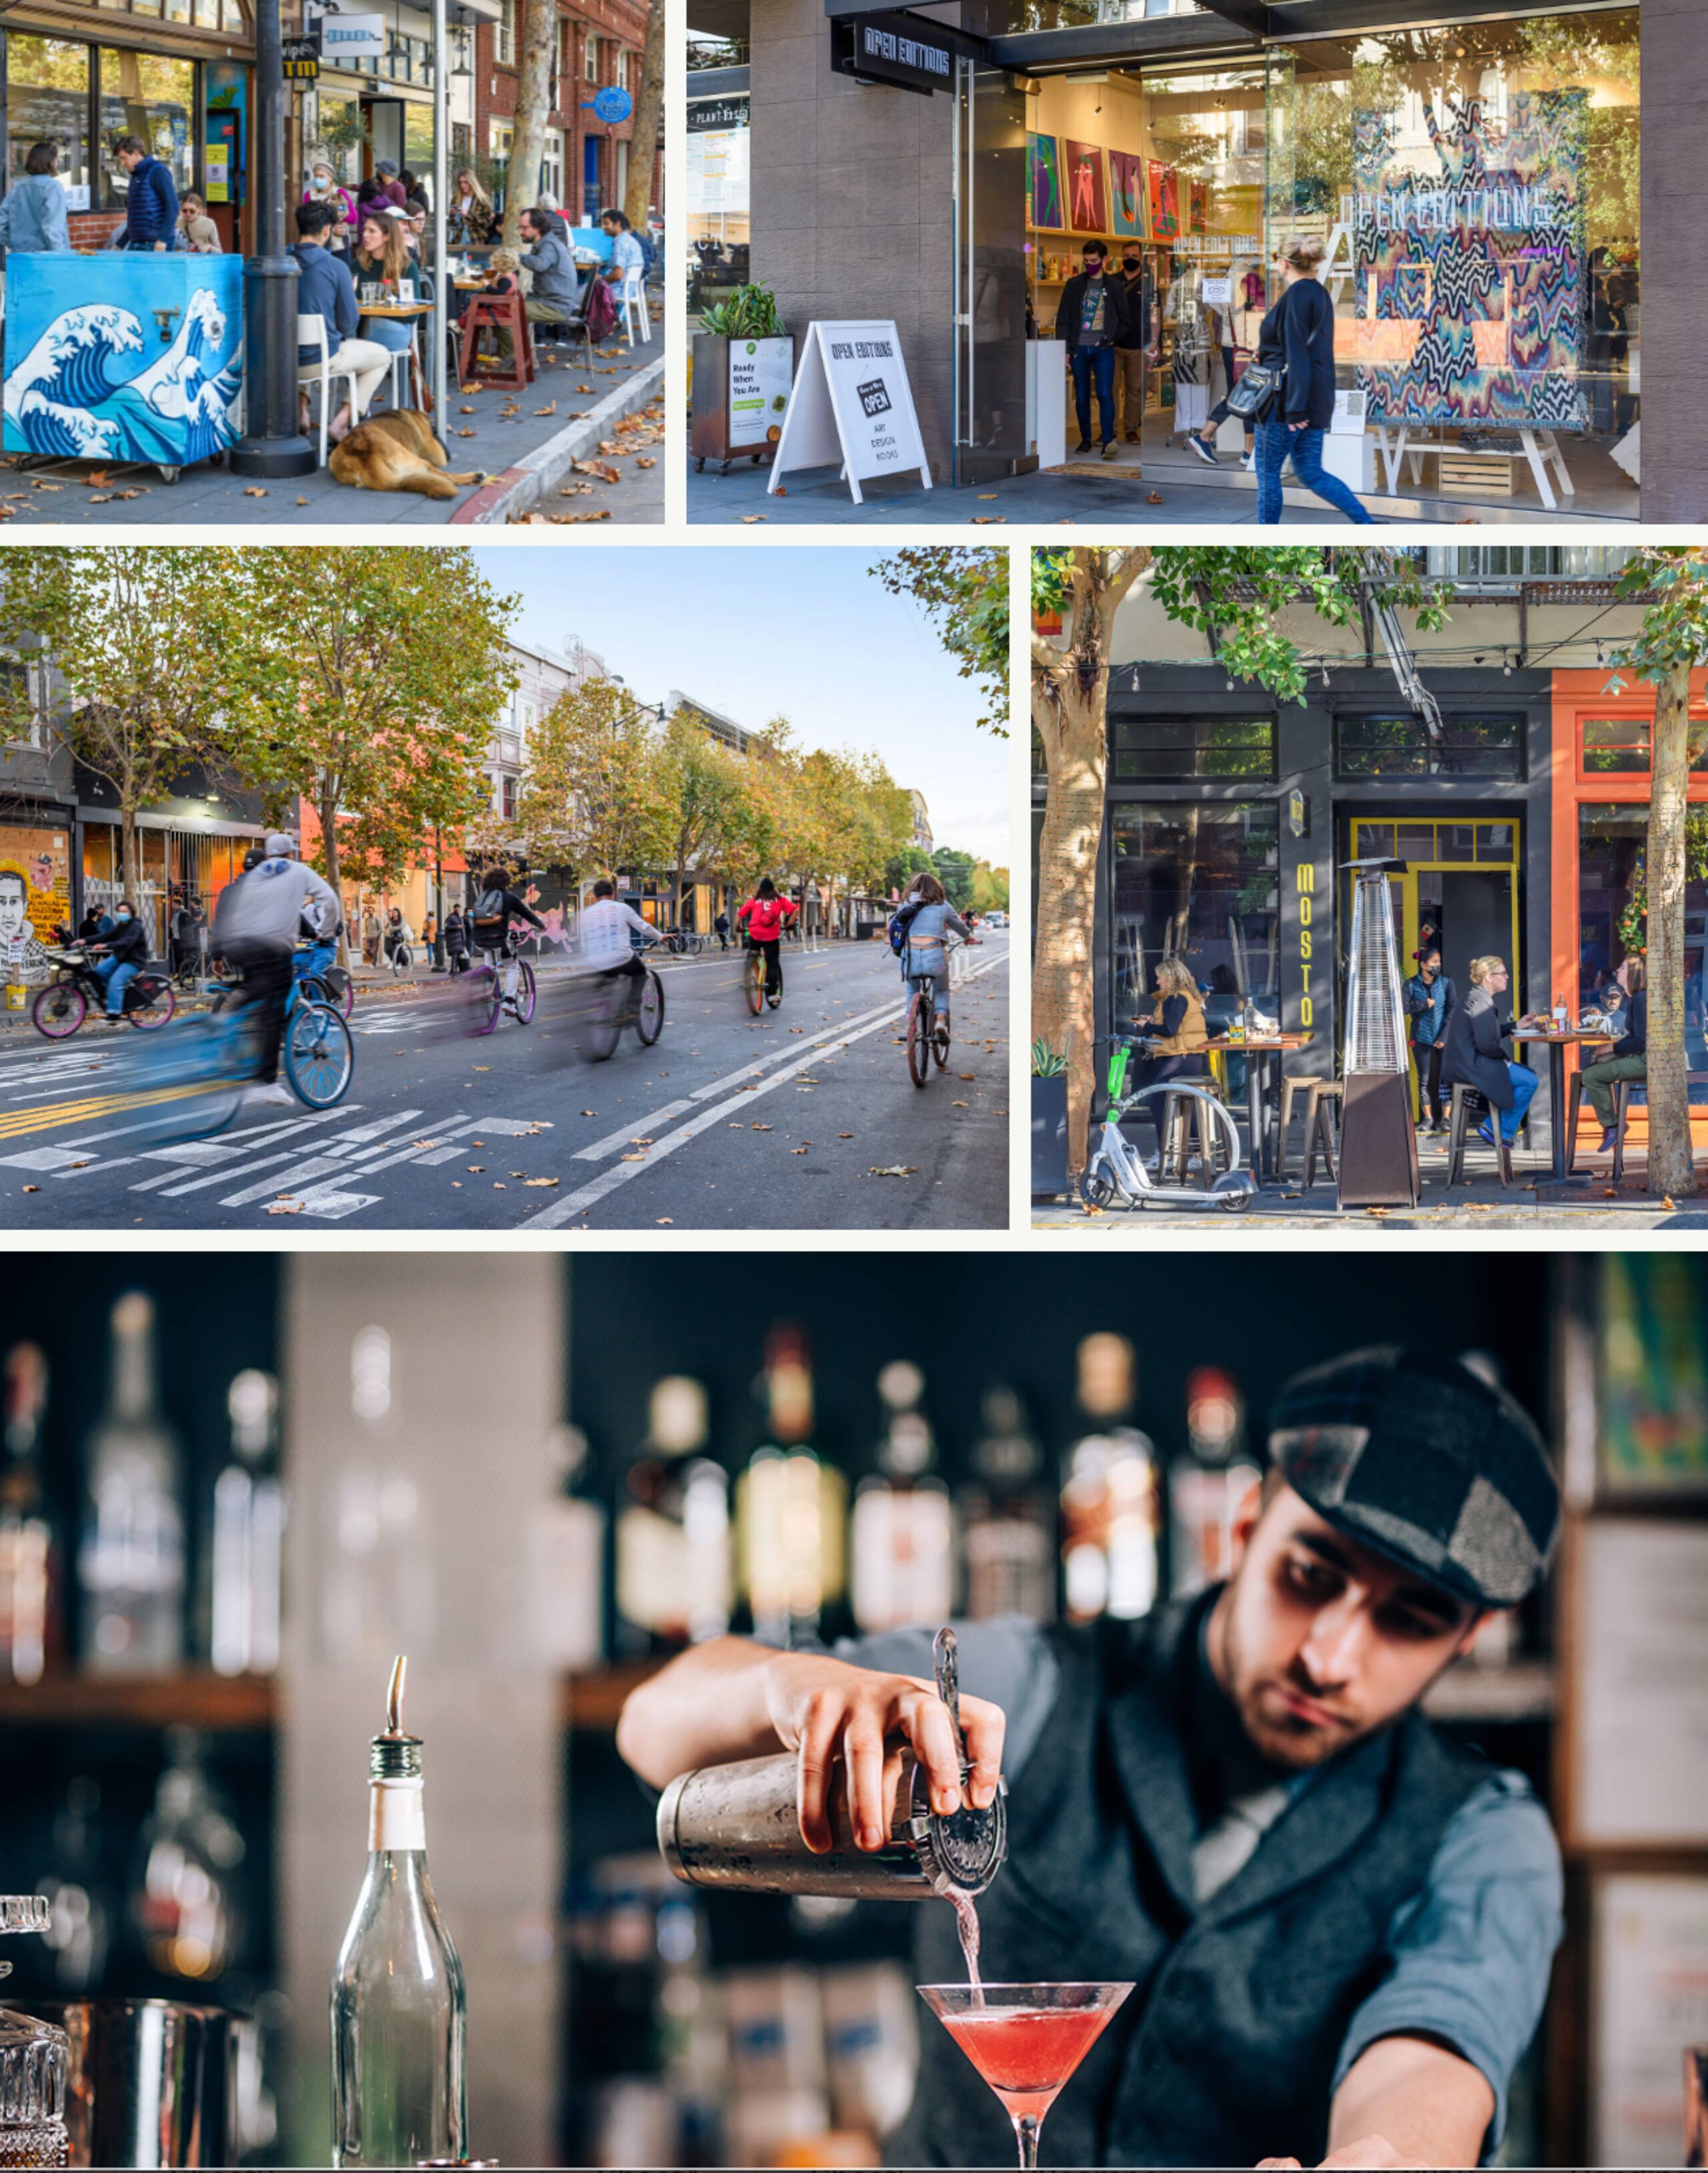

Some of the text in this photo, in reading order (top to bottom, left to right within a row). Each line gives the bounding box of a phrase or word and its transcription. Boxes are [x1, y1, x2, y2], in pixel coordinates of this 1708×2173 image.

[865, 27, 949, 76] OPEN EDITIONS
[282, 61, 318, 77] TM
[1341, 185, 1550, 231] OPEN EDITIONS
[1174, 236, 1202, 254] OPEN
[831, 340, 893, 360] OPEN EDITIONS
[733, 363, 755, 373] Ready
[733, 386, 747, 395] You
[865, 391, 889, 413] OPEN
[874, 424, 885, 433] ART
[871, 436, 896, 448] DESIGN
[876, 450, 899, 462] BOOKS
[1297, 863, 1314, 1027] MOSTO
